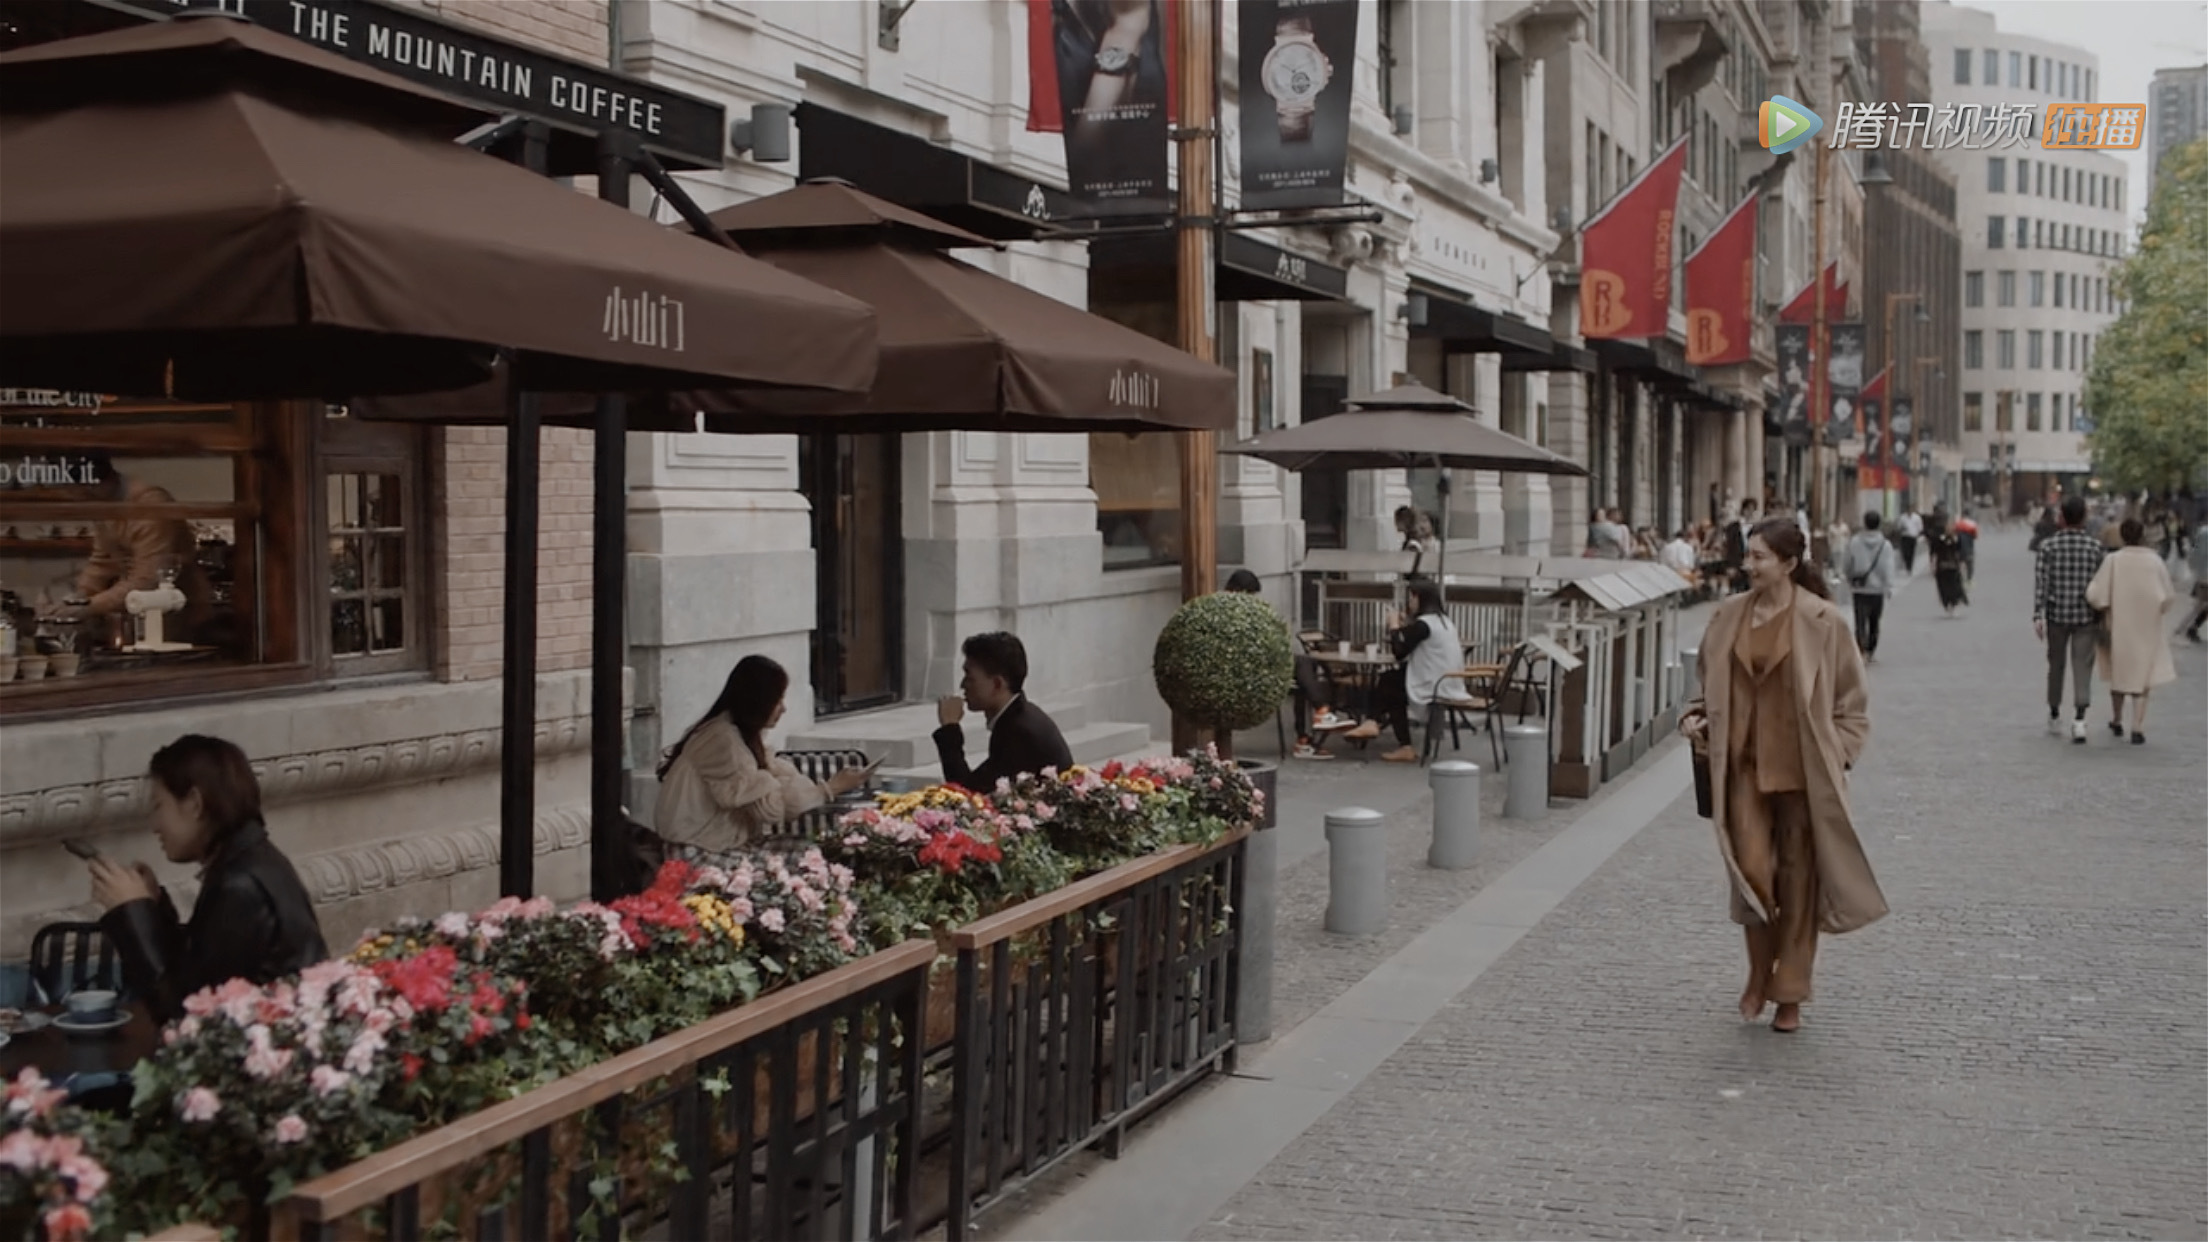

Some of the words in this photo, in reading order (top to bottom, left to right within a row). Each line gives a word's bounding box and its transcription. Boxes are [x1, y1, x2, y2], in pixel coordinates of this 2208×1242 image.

[289, 1, 349, 47] THE
[368, 23, 532, 98] MOUNTAIN
[551, 75, 662, 135] COFFEE
[602, 285, 685, 352] 小山门
[16, 455, 76, 484] drink
[79, 456, 102, 484] it.
